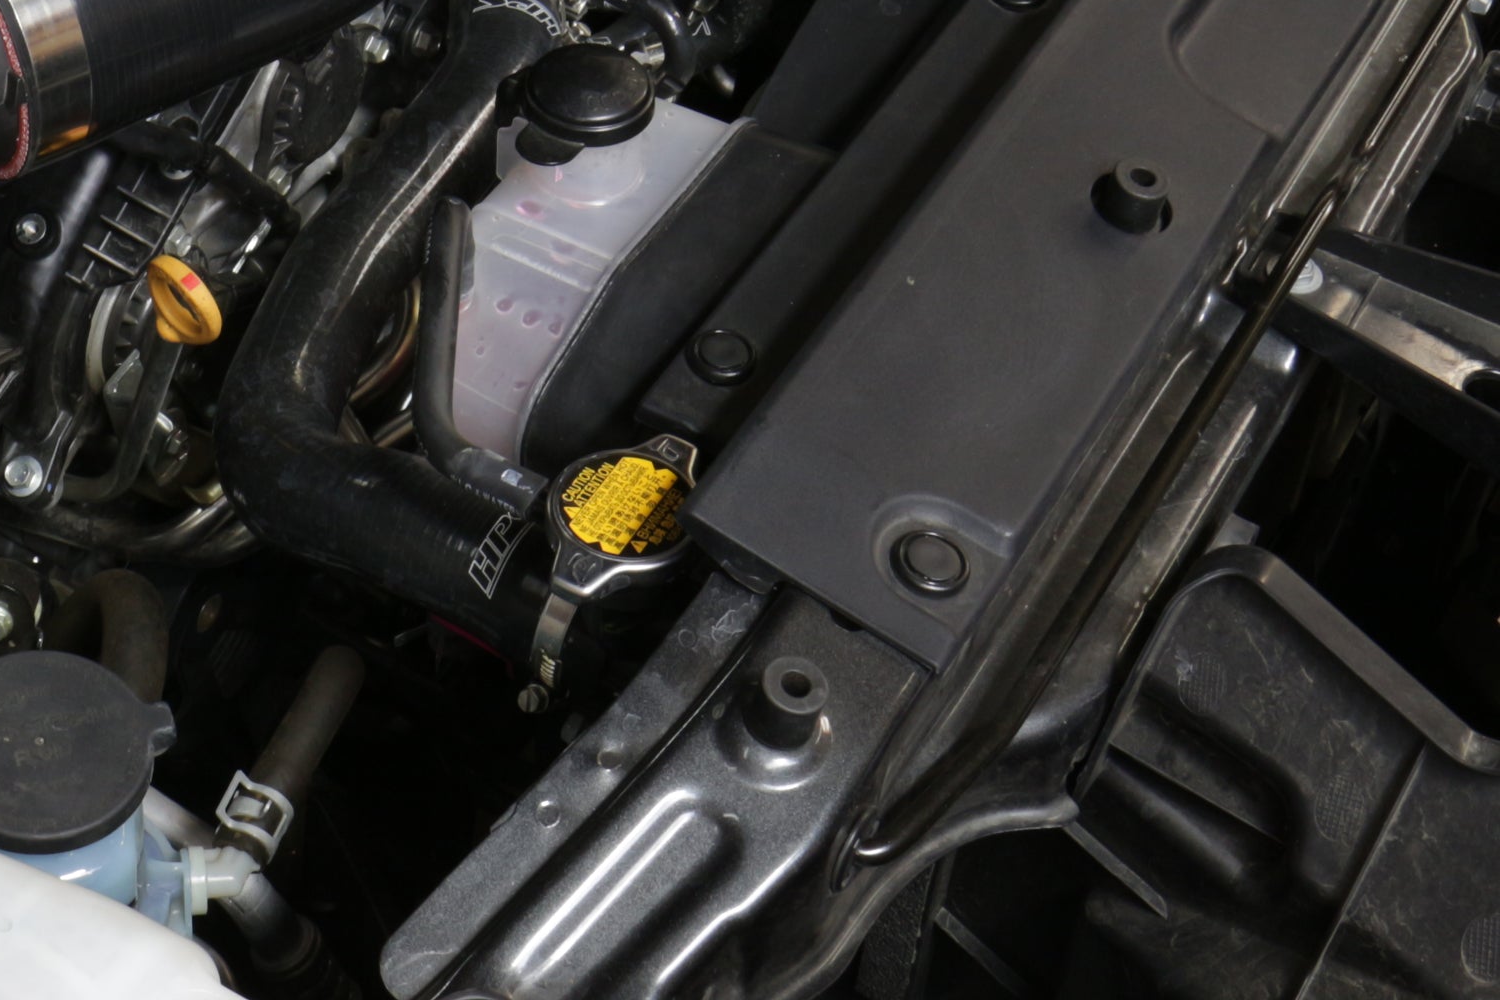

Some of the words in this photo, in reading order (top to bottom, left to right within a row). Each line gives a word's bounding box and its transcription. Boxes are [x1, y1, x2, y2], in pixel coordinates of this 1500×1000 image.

[561, 465, 595, 501] CAUTION
[572, 505, 592, 528] NEVER
[589, 489, 606, 508] OPEN
[602, 470, 620, 491] WHEN
[573, 461, 614, 508] ATTENTION
[468, 511, 536, 600] HP
